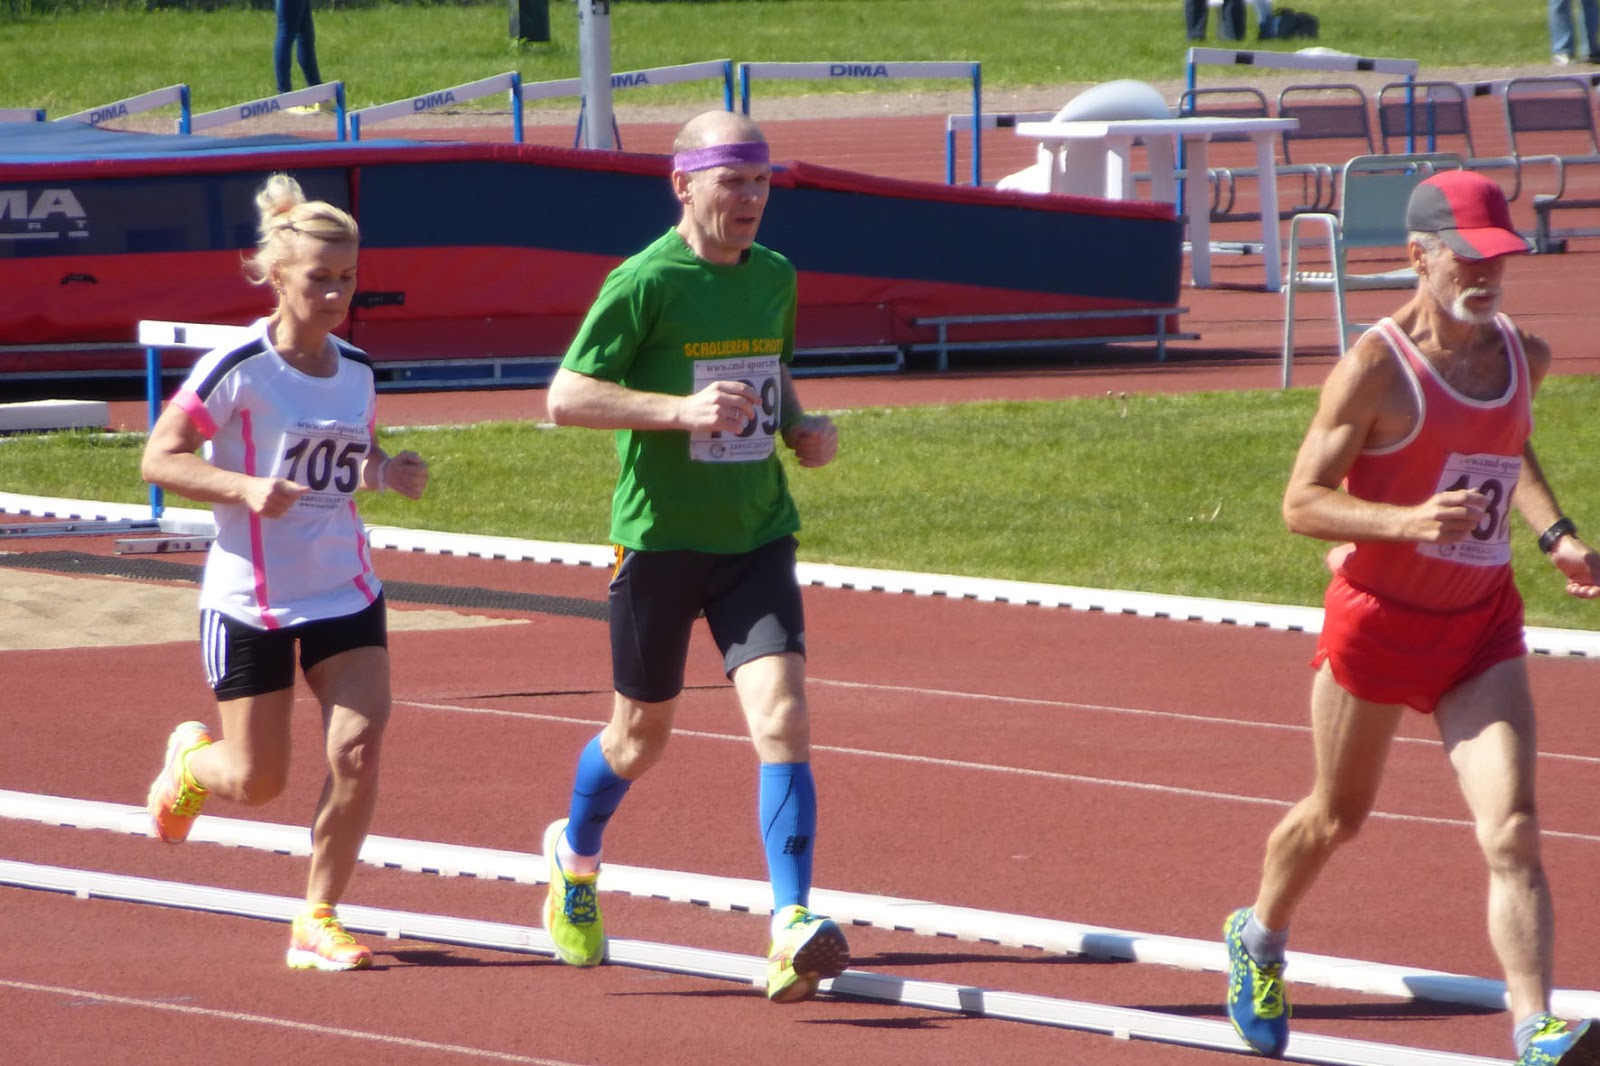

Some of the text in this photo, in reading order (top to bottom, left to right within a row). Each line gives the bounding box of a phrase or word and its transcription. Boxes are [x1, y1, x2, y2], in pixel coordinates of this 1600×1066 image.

[829, 64, 889, 78] DIMA
[240, 99, 281, 120] DIMA
[413, 91, 456, 112] DIMA
[90, 103, 128, 125] DIMA
[685, 341, 750, 357] SCHOLIEREN
[284, 437, 369, 493] 105
